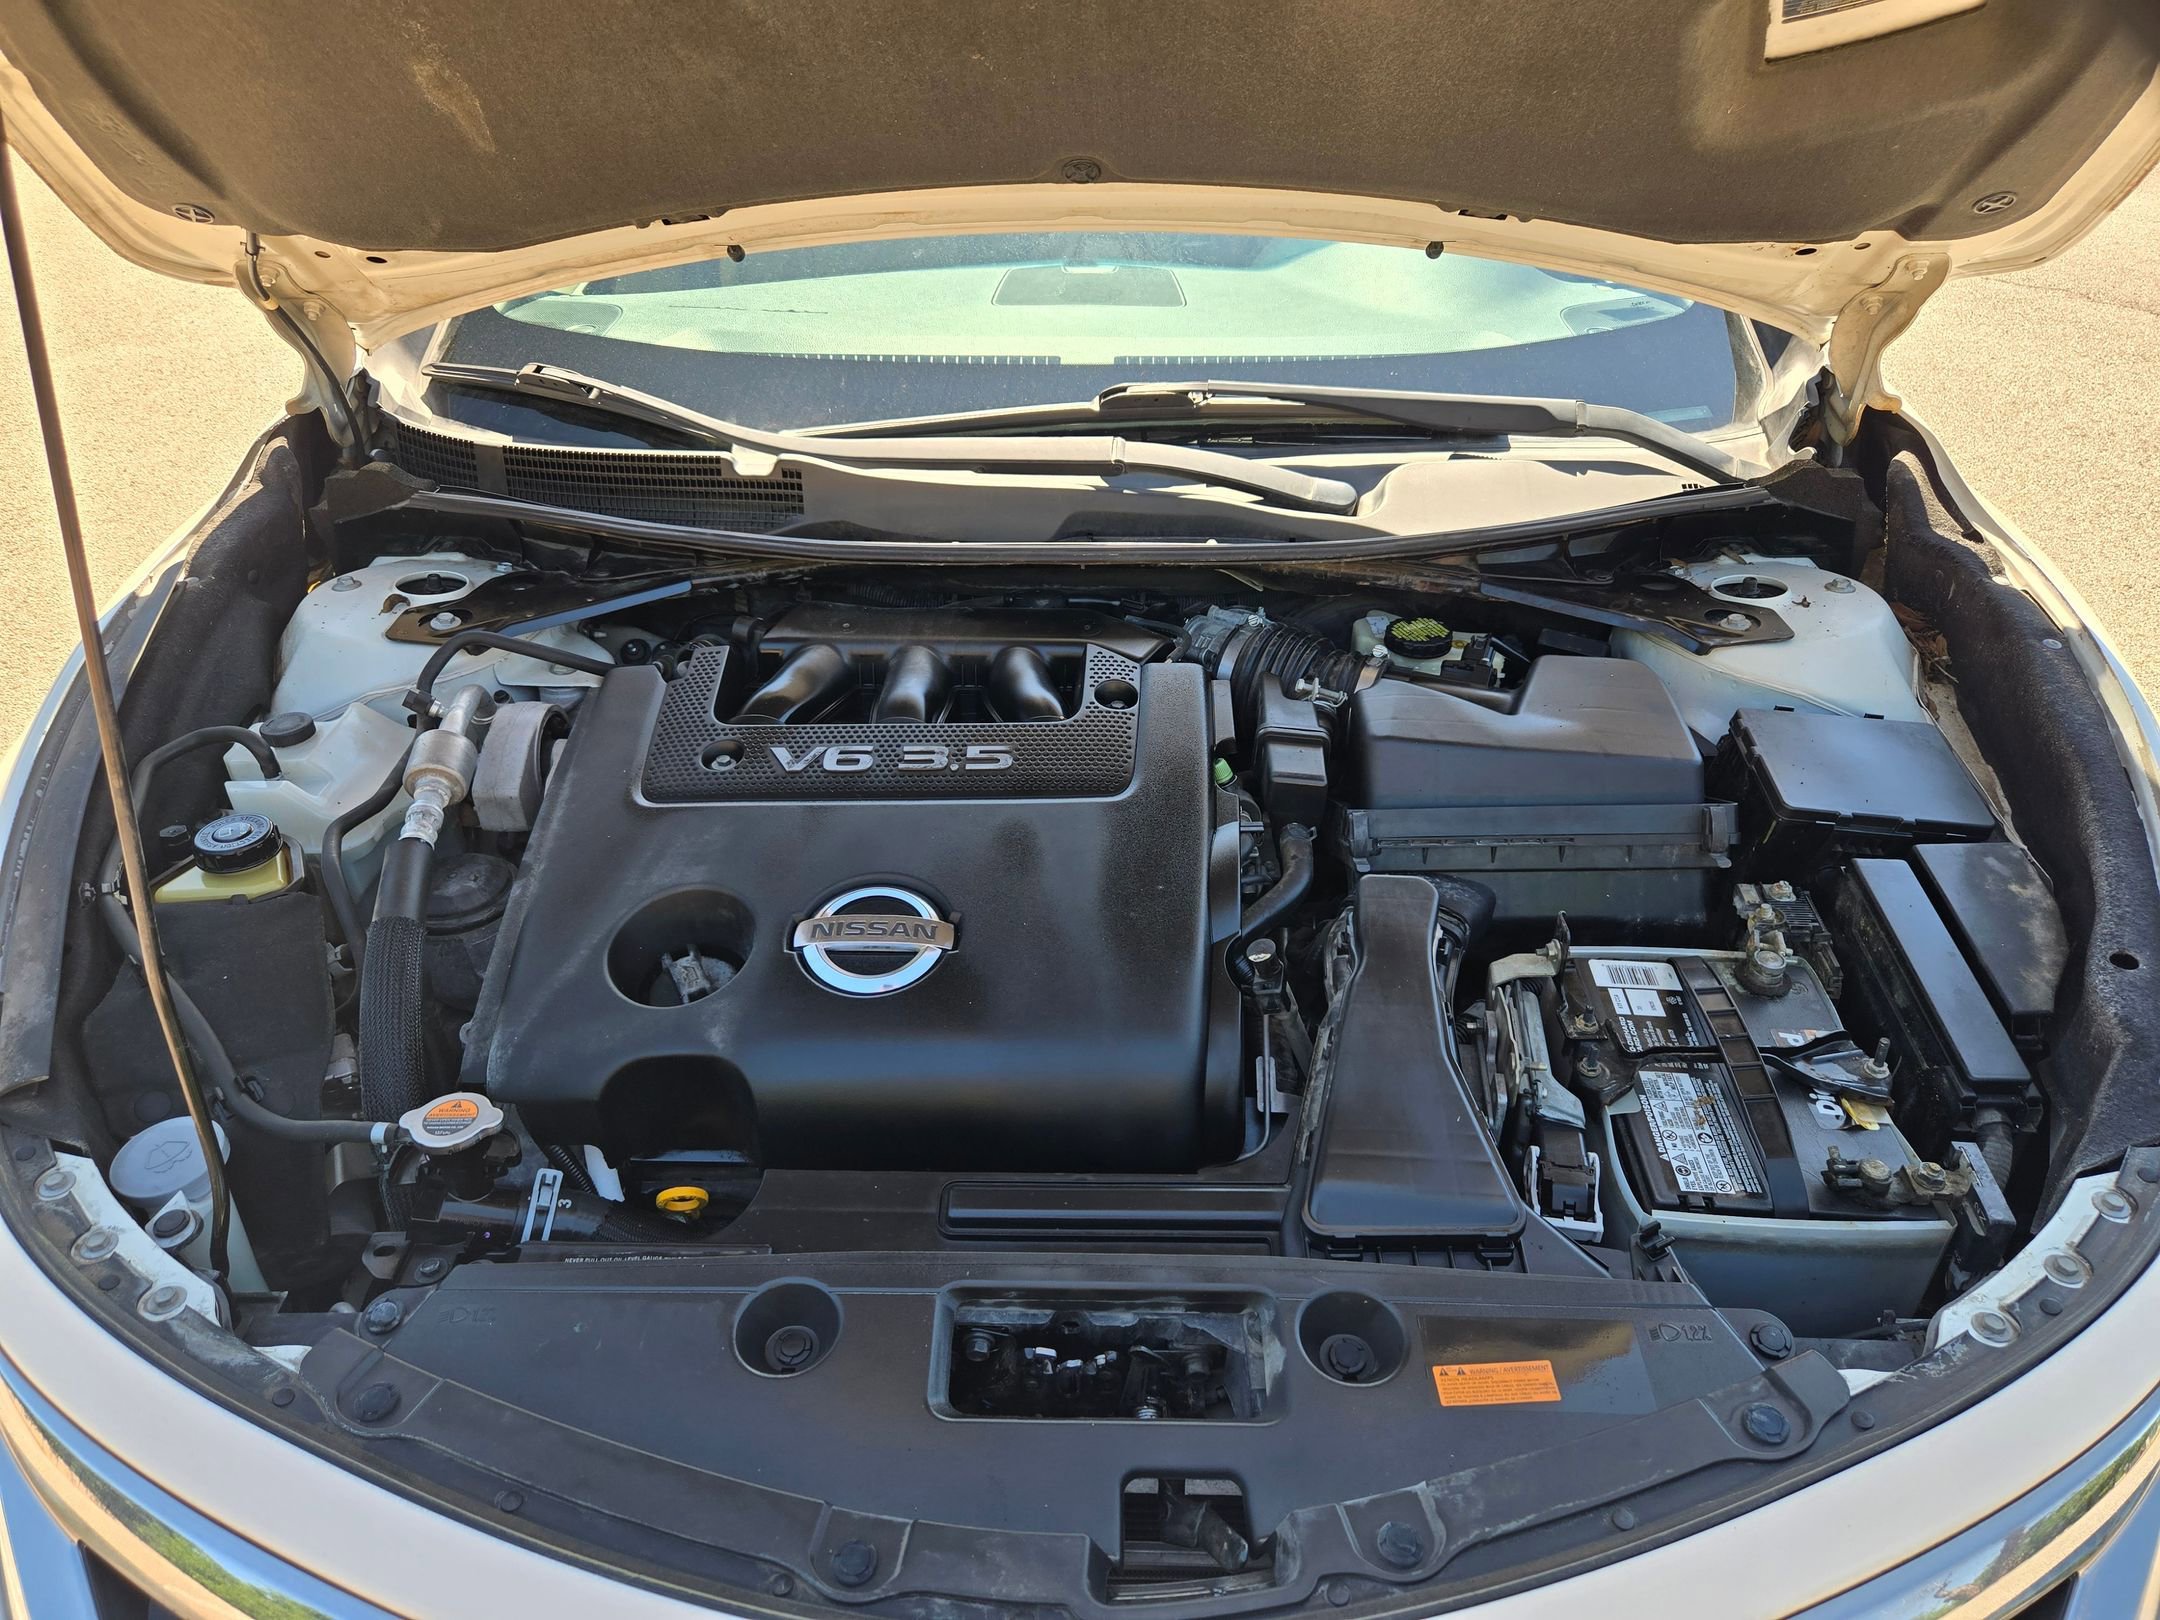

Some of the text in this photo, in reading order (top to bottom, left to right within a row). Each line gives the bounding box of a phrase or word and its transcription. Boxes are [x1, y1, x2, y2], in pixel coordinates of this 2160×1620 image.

[770, 746, 1014, 772] V6 3.5
[810, 921, 939, 942] NISSAN
[1639, 1094, 1666, 1152] DANGER/POISON
[1469, 1367, 1499, 1376] WARNING
[1502, 1364, 1550, 1374] AVERTISSEMENT
